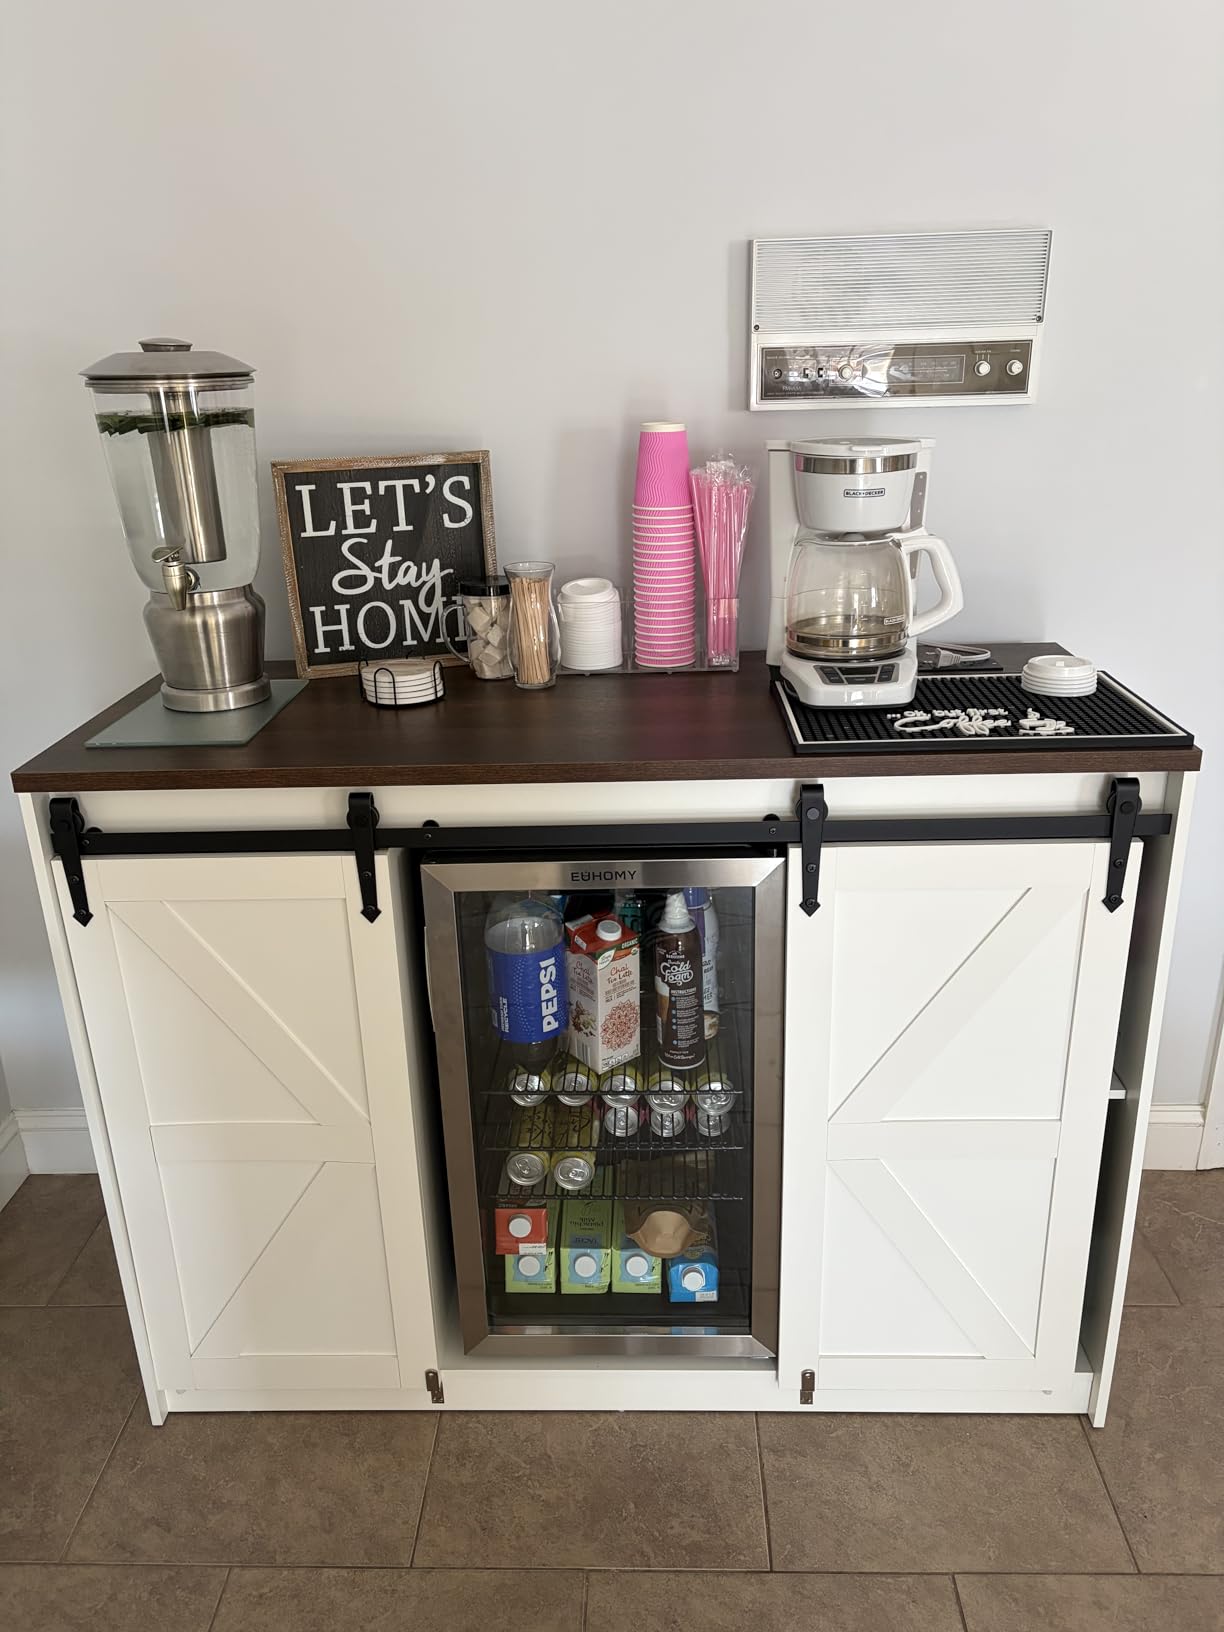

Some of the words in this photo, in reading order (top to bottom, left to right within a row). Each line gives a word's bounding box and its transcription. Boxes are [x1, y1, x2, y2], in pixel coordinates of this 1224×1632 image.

[295, 474, 473, 537] LET'S
[331, 537, 454, 614] Stay
[539, 956, 559, 1033] PEPSI
[610, 963, 629, 976] Chai
[660, 960, 691, 975] Cold
